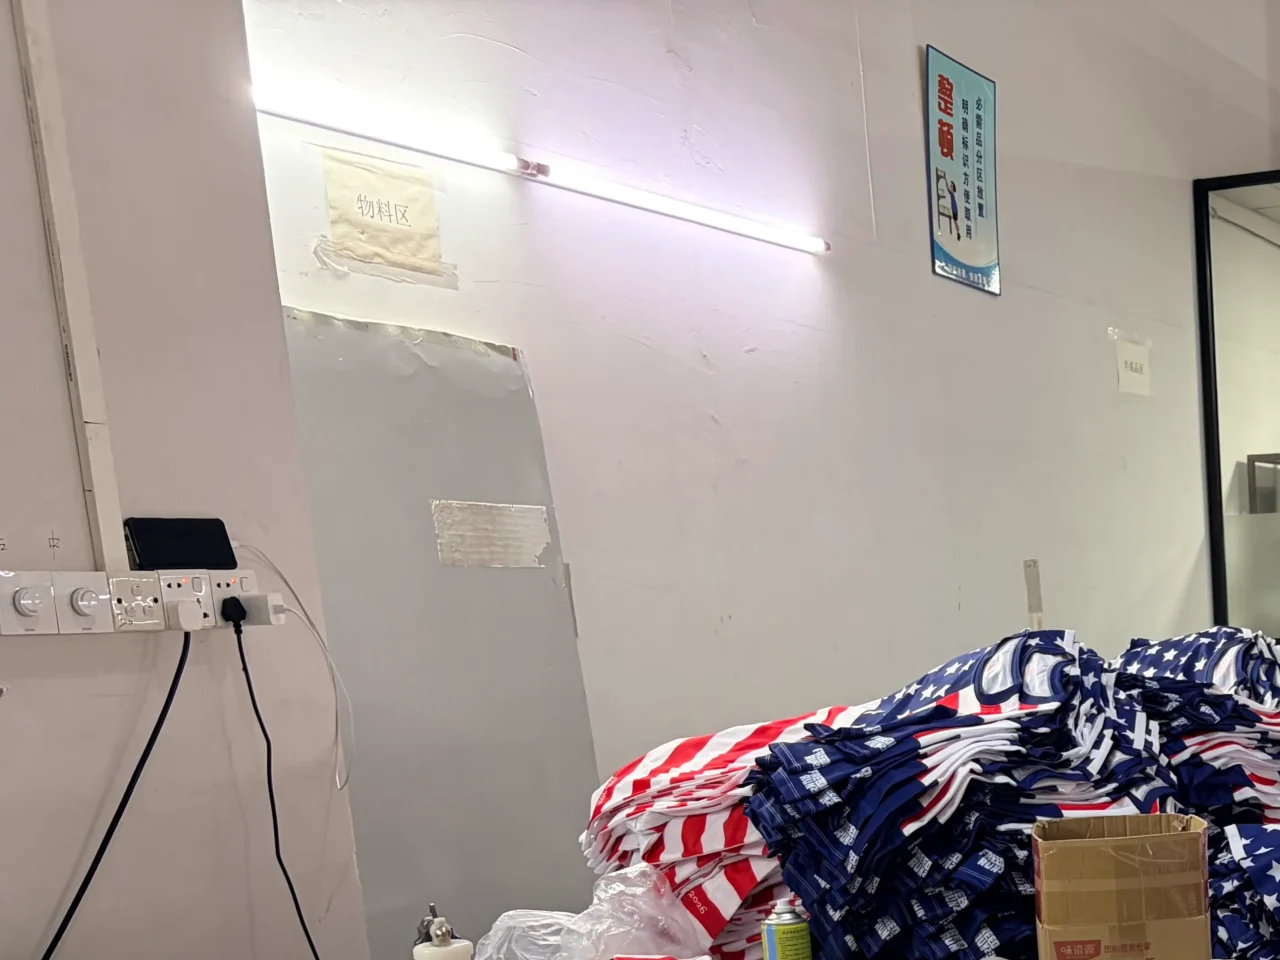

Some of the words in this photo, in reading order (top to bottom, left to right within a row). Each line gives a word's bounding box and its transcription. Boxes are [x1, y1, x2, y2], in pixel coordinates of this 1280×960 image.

[356, 193, 412, 227] 物料区
[688, 890, 708, 915] 2026
